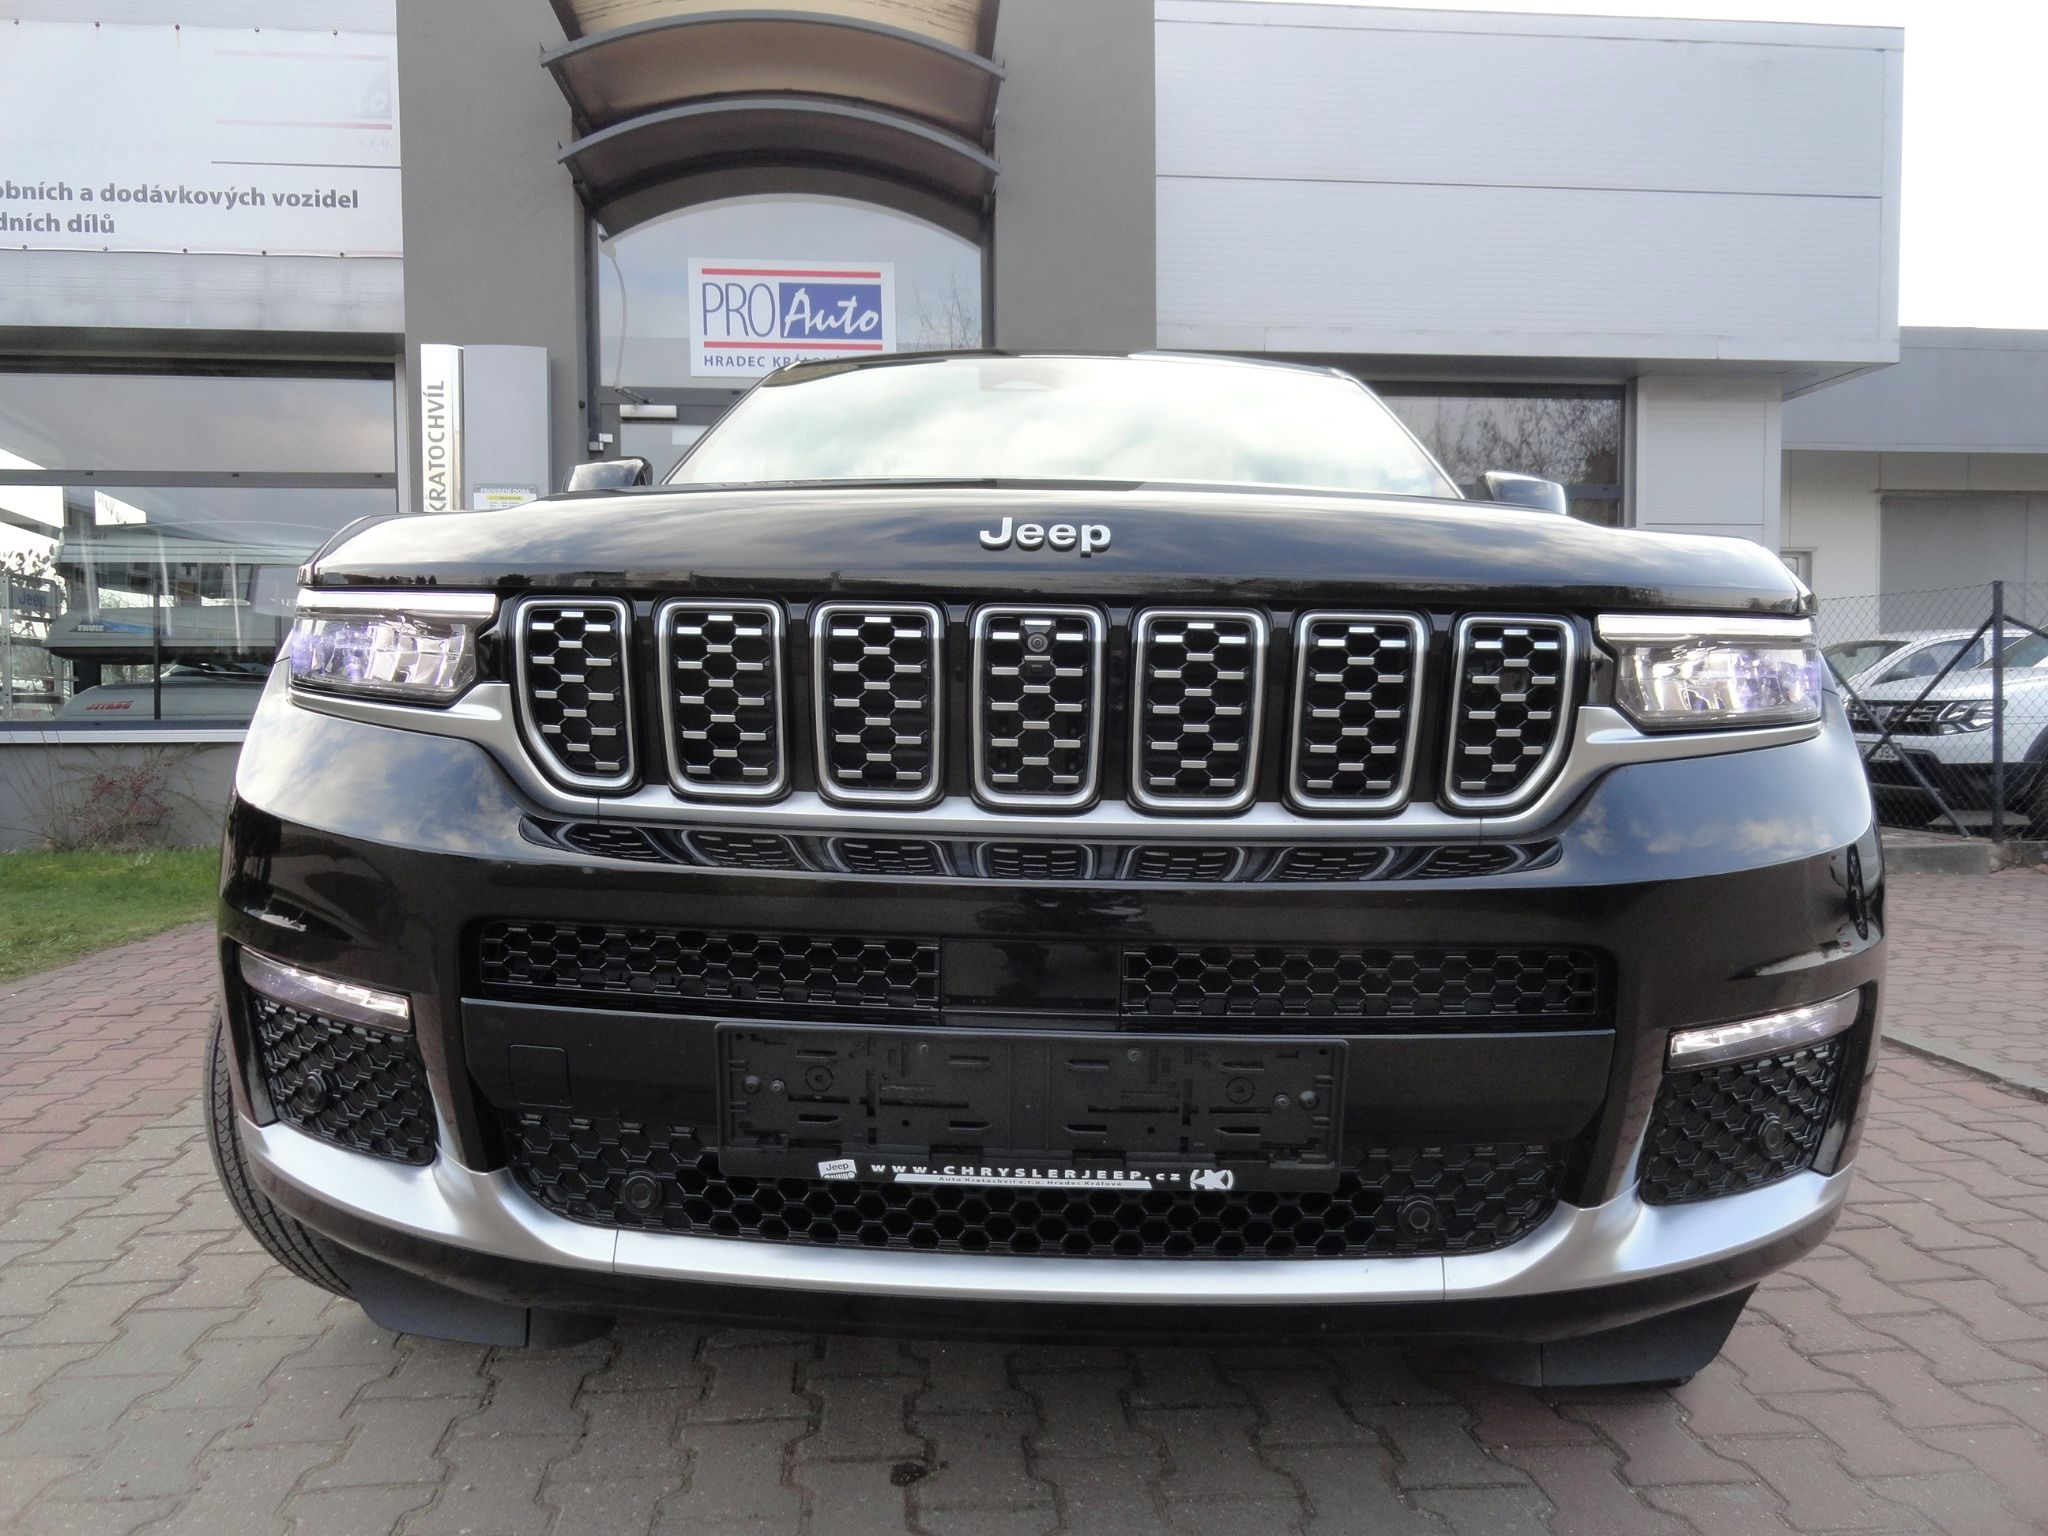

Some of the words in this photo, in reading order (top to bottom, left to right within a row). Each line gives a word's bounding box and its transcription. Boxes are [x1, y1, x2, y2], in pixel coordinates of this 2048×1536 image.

[80, 187, 93, 201] a
[100, 183, 265, 210] dodávkových
[272, 188, 358, 209] vozidel
[67, 213, 115, 234] dílů
[702, 282, 775, 337] PRO
[783, 287, 879, 337] Auto
[704, 355, 765, 367] HRADEC
[979, 516, 1111, 558] Jeep
[18, 589, 47, 608] Jeep
[825, 1162, 849, 1172] Jeep
